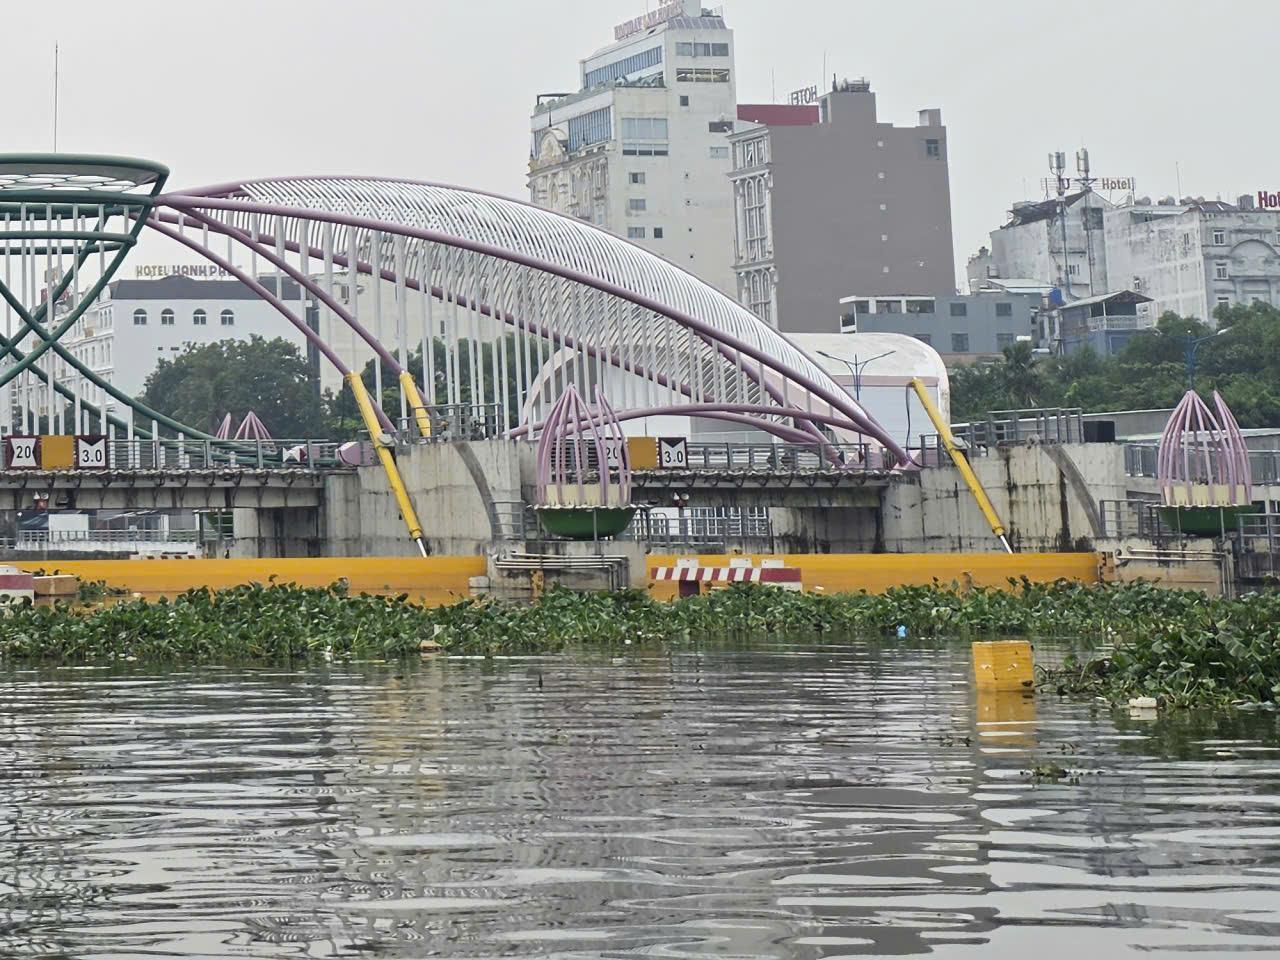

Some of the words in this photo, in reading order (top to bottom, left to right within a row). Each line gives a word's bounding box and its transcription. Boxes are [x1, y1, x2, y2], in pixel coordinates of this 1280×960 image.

[1102, 178, 1131, 190] Hotel
[136, 264, 168, 276] HOTEL
[16, 445, 32, 459] 20
[82, 449, 103, 463] 3.0
[664, 450, 684, 464] 3.0
